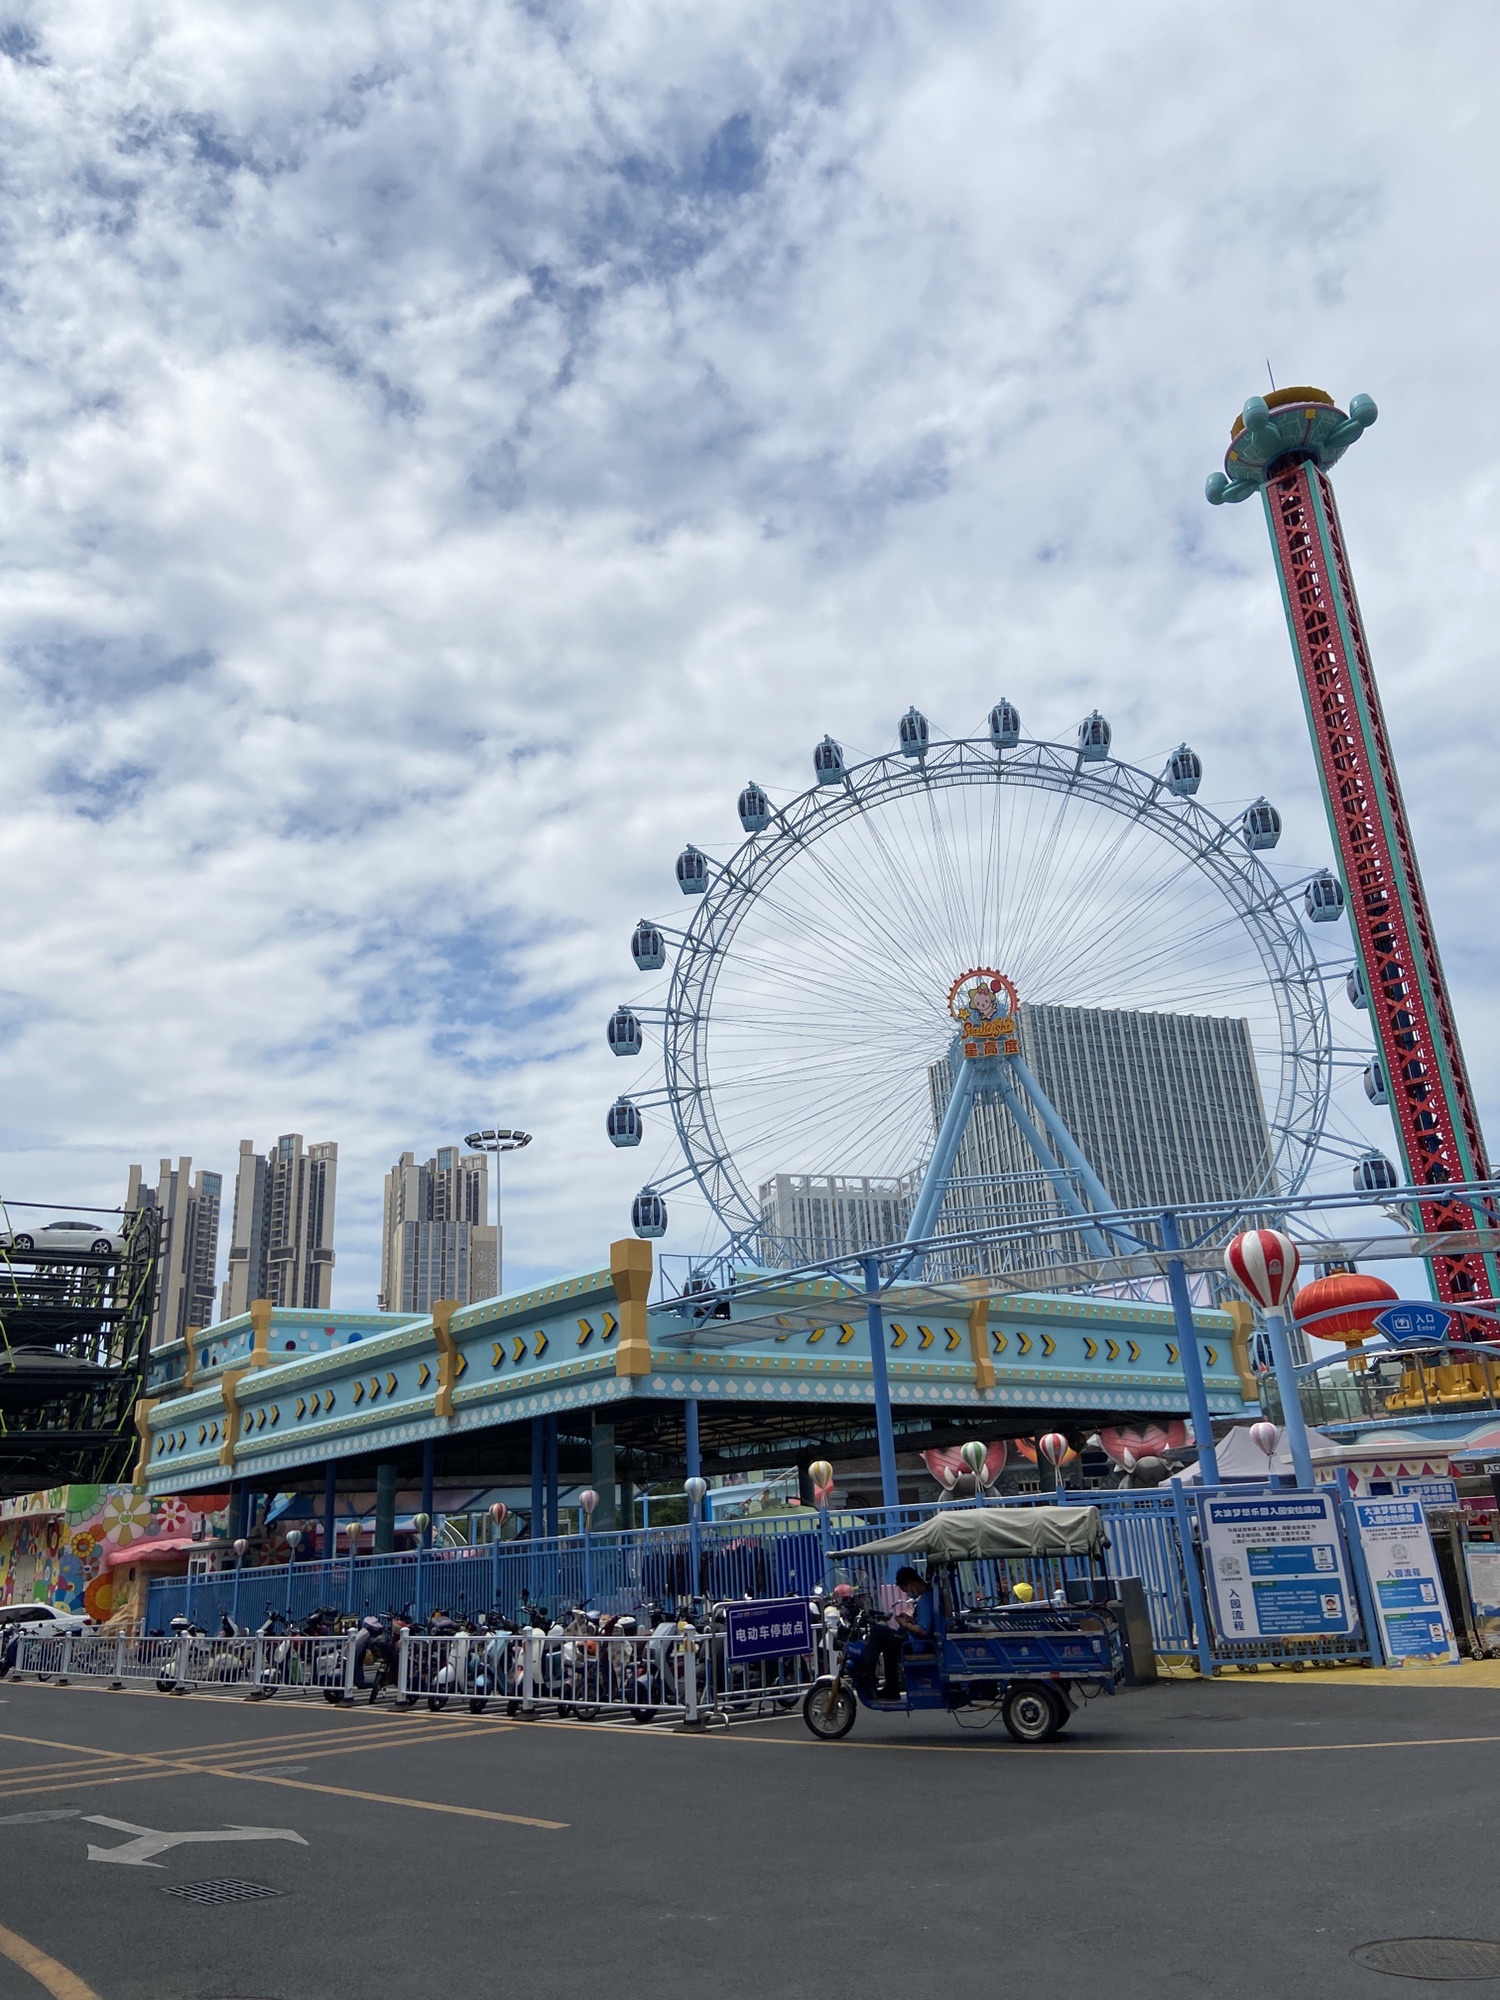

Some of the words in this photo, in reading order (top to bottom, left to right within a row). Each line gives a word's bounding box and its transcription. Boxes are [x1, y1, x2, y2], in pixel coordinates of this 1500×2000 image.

[1415, 1314, 1435, 1323] 入口
[1487, 1464, 1500, 1472] 入口
[1229, 1588, 1245, 1631] 入园流程
[735, 1620, 804, 1642] 电动车停放点
